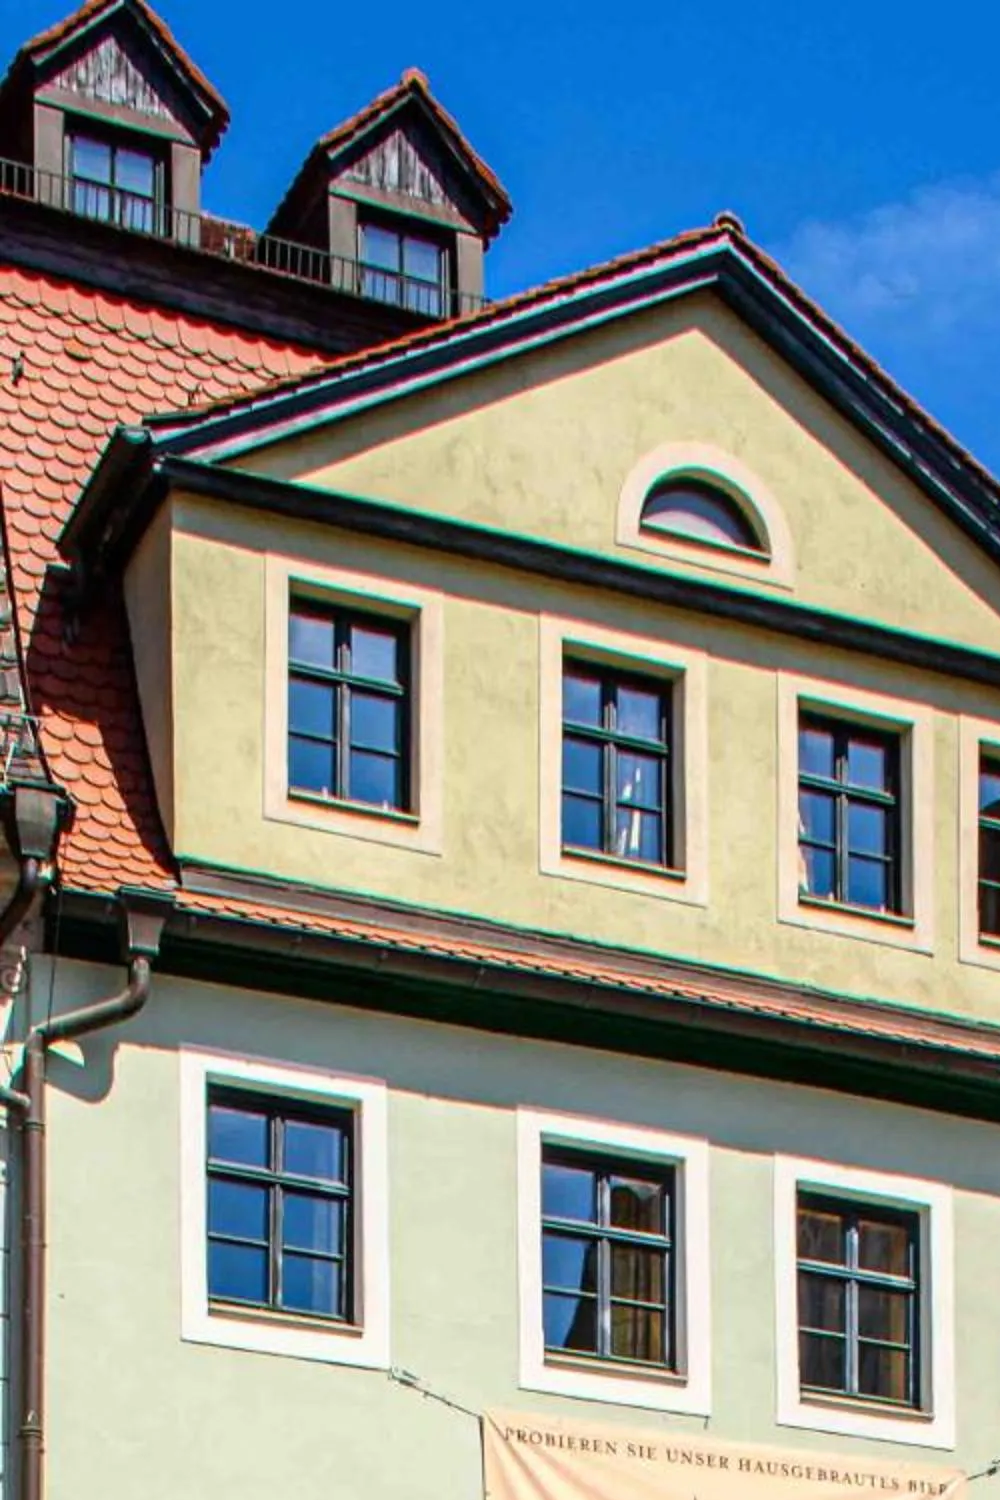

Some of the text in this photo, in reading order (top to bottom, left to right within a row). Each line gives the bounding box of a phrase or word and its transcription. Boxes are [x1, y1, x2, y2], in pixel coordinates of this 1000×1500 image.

[505, 1426, 617, 1455] PROBIEREN
[627, 1442, 657, 1460] SIE
[666, 1449, 729, 1469] UNSER
[738, 1457, 900, 1491] HAUSGEBRAUTES
